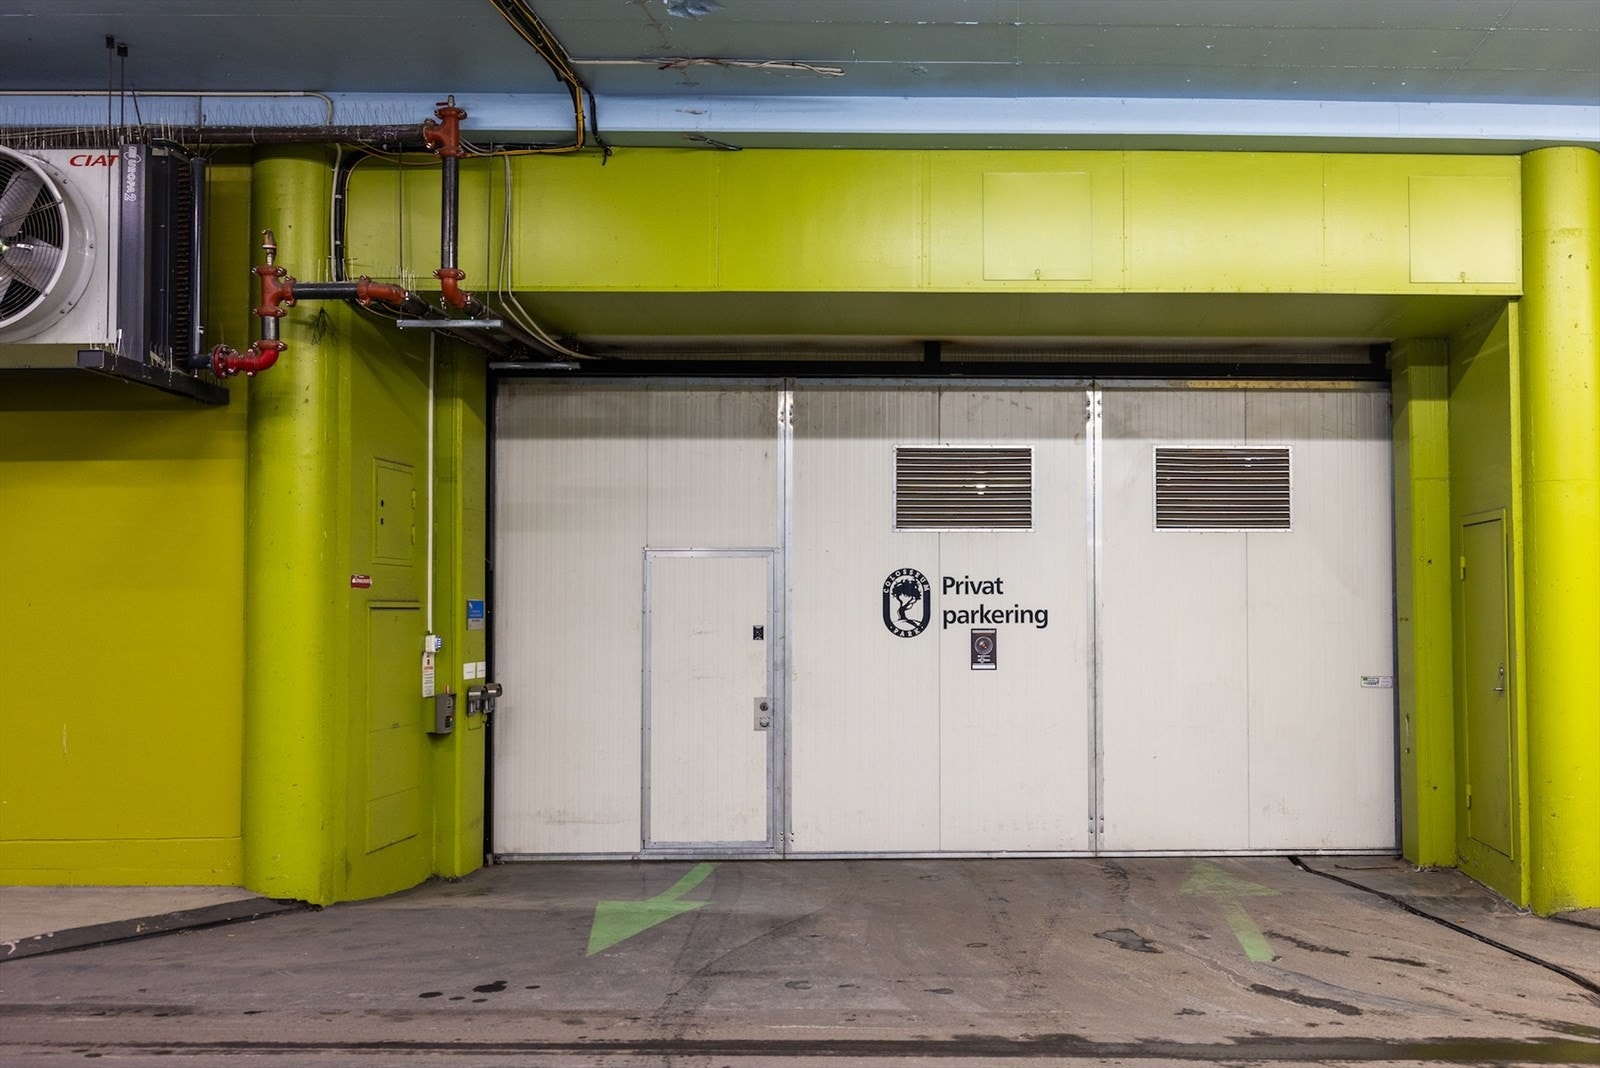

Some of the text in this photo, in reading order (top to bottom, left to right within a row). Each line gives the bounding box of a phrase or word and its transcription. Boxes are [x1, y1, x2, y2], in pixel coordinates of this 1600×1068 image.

[69, 154, 119, 167] CIAT
[883, 568, 931, 594] COLOSSEUM
[942, 575, 1004, 595] Privat
[942, 604, 1049, 629] parkering
[893, 628, 921, 637] PARK
